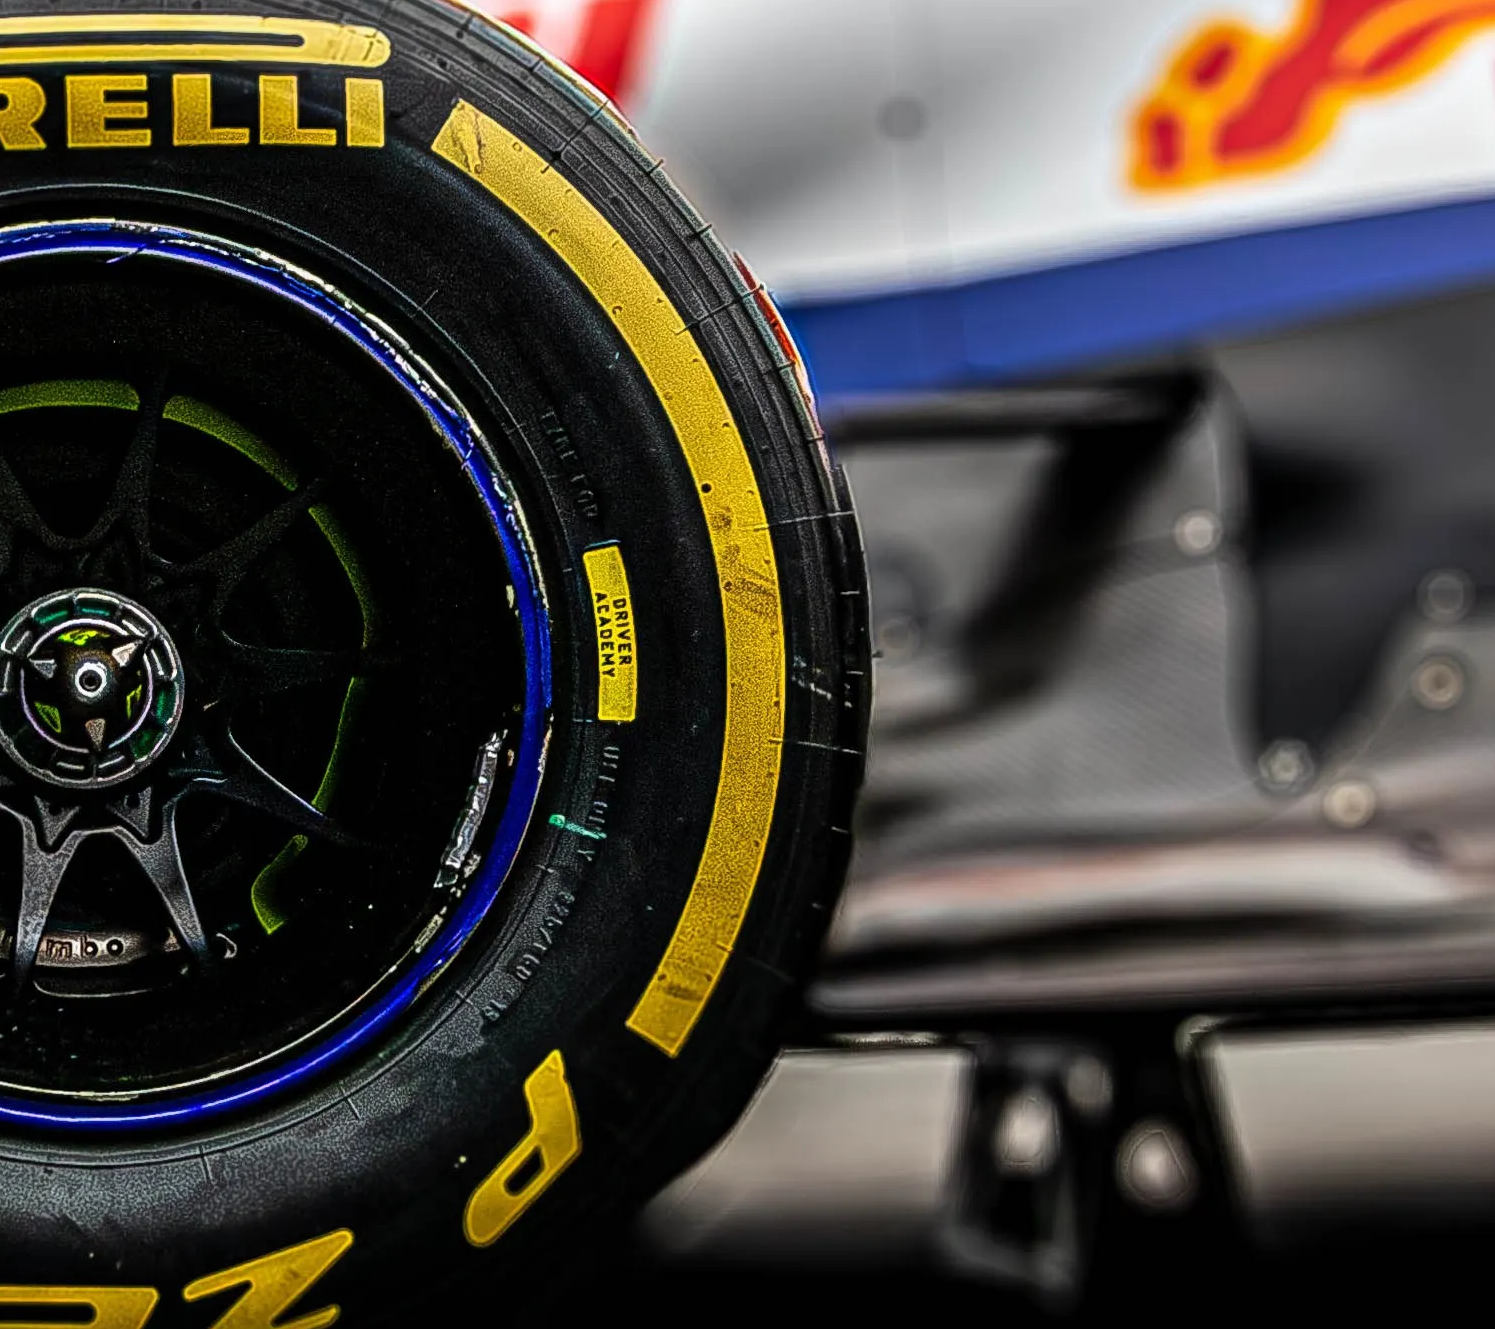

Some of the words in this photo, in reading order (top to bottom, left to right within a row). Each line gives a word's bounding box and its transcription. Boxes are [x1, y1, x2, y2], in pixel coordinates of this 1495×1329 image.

[595, 592, 616, 679] ACADEMY
[612, 597, 633, 666] DRIVER
[463, 1049, 580, 1246] P
